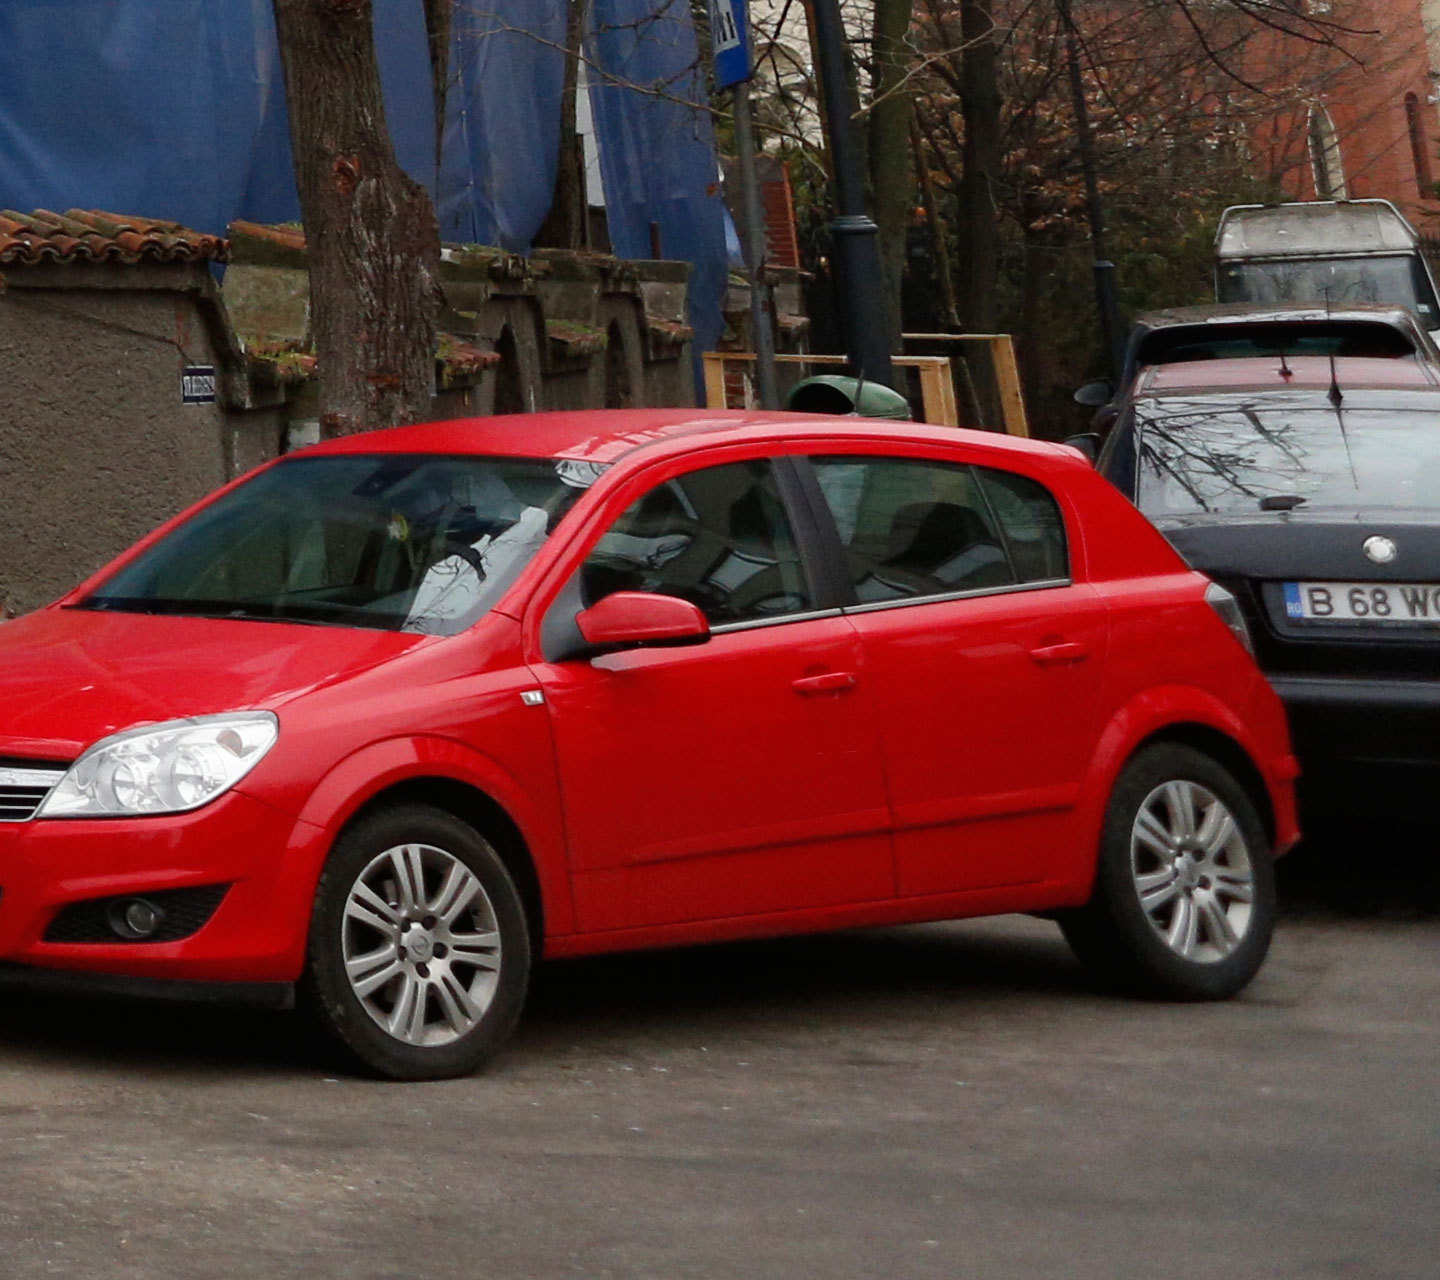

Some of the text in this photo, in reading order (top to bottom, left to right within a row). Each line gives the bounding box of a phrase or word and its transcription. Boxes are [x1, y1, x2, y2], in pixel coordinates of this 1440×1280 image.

[1286, 602, 1302, 614] RO
[1308, 587, 1333, 616] B
[1348, 587, 1392, 617] 68
